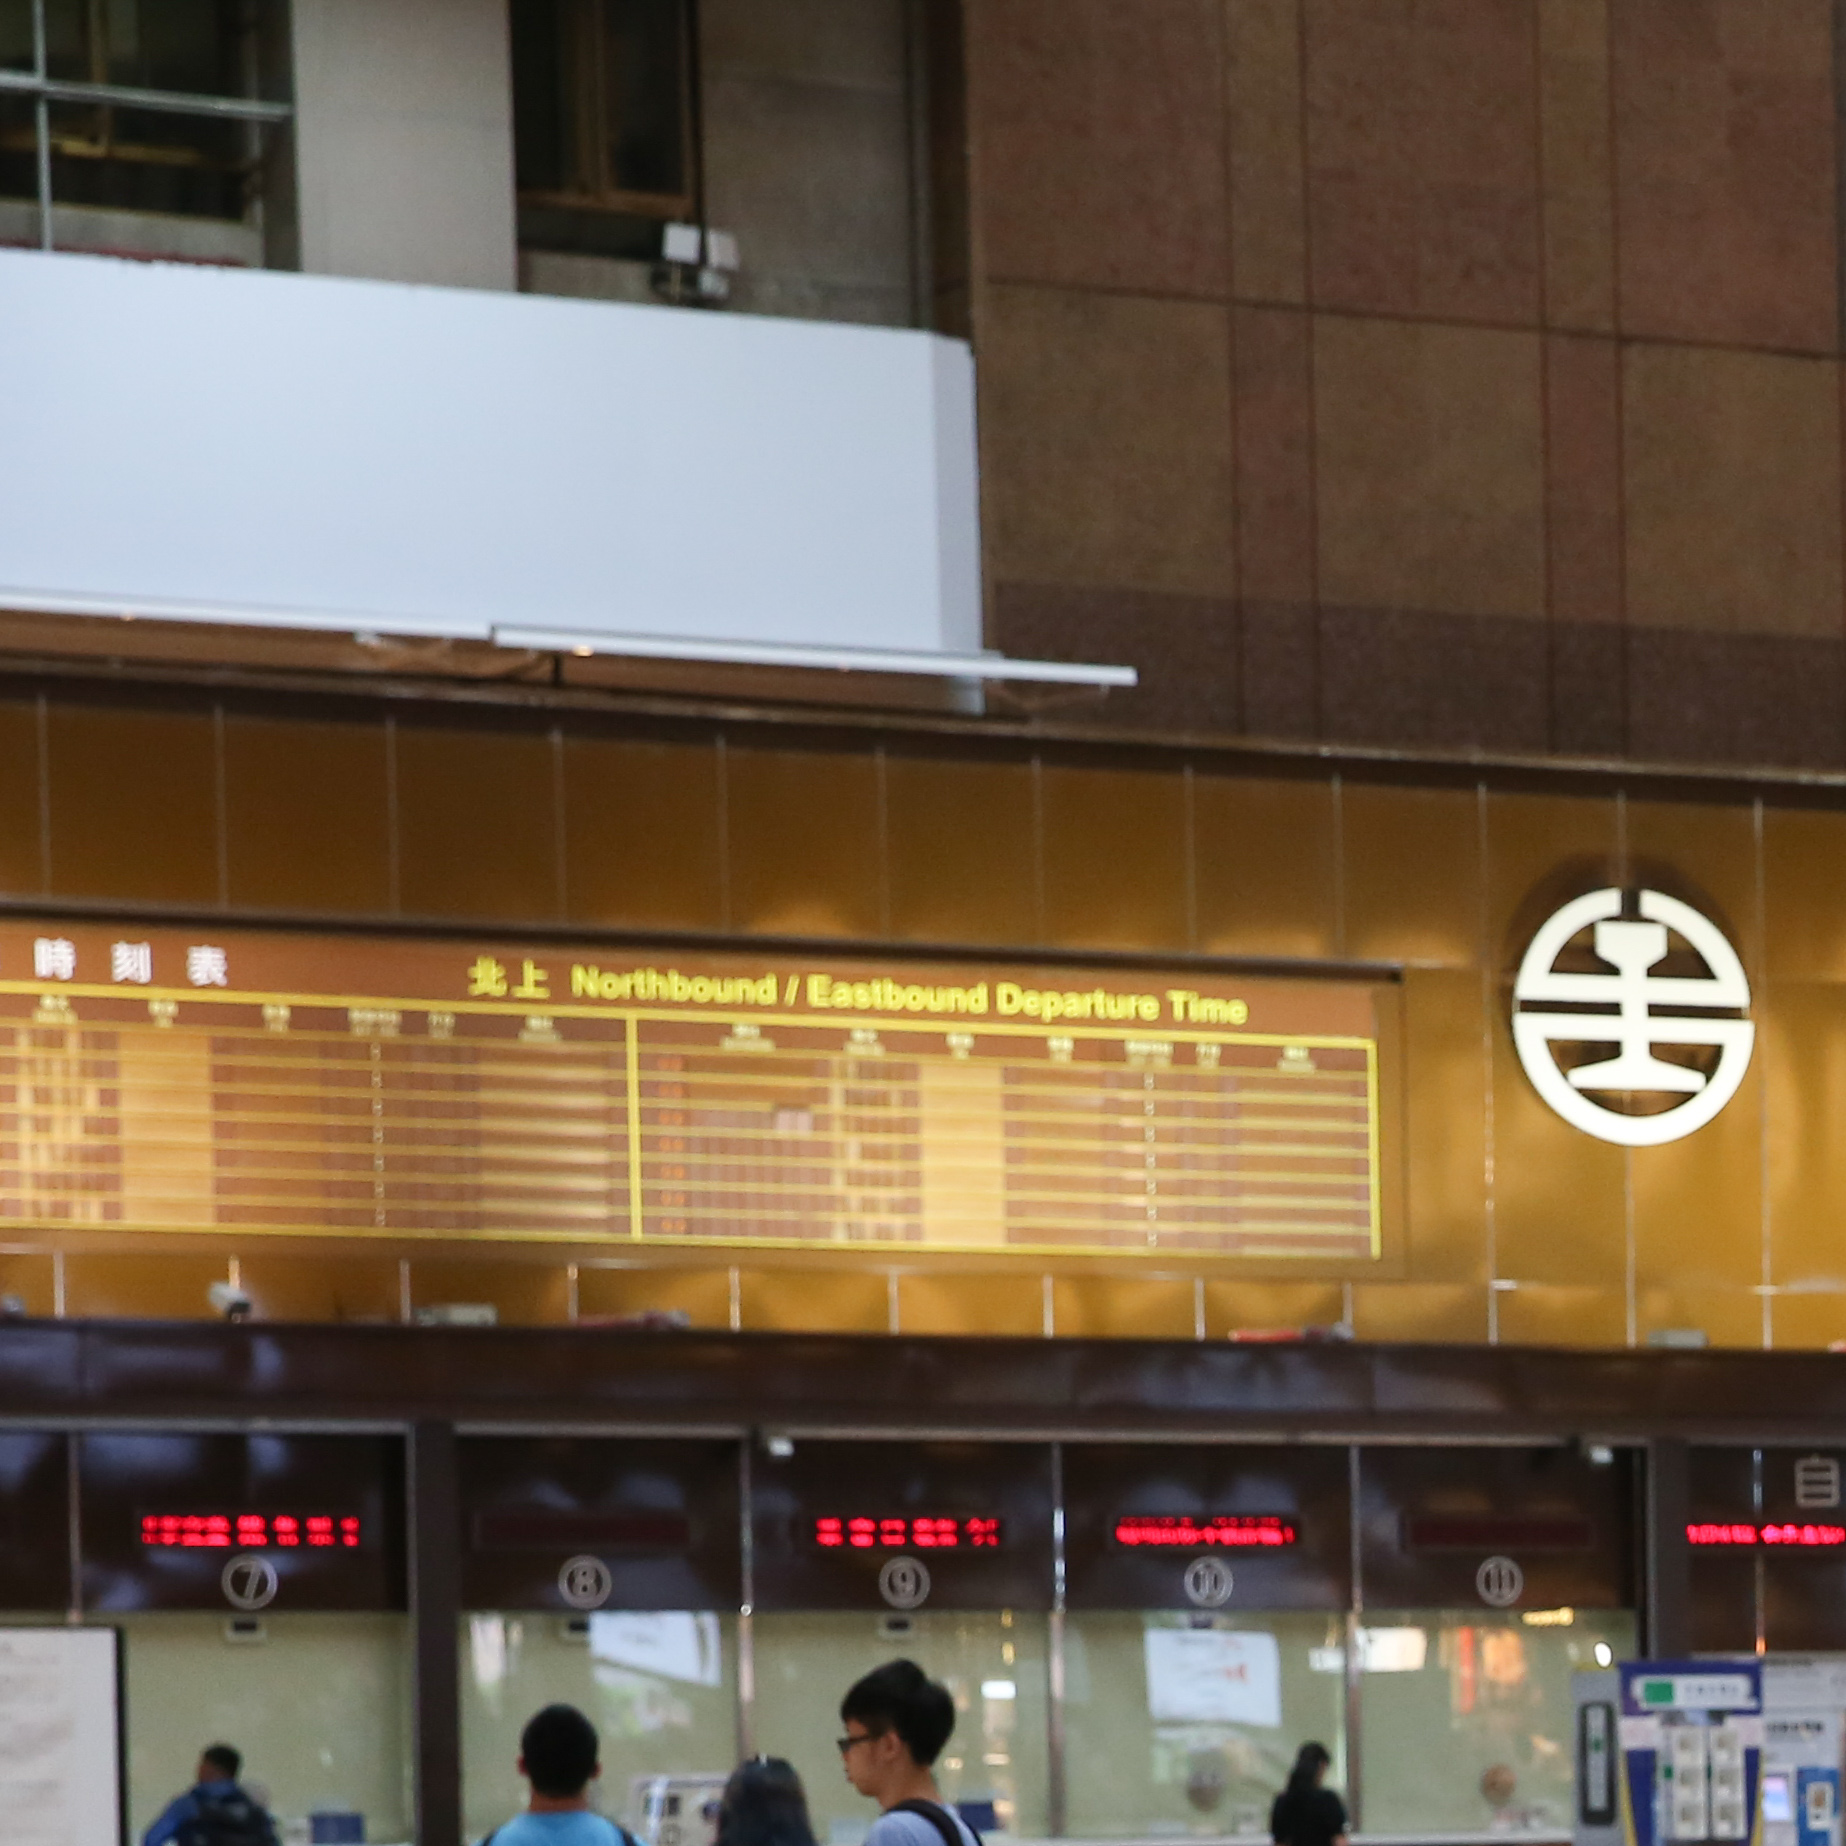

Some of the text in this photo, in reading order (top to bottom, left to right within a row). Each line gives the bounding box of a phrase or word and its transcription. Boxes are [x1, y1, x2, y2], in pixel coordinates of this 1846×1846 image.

[33, 937, 227, 986] 時刻表
[467, 956, 551, 998] 北上
[570, 963, 778, 1006] Northbound
[806, 974, 988, 1014] Eastbound
[996, 982, 1161, 1022] Departure
[1166, 989, 1249, 1025] Time
